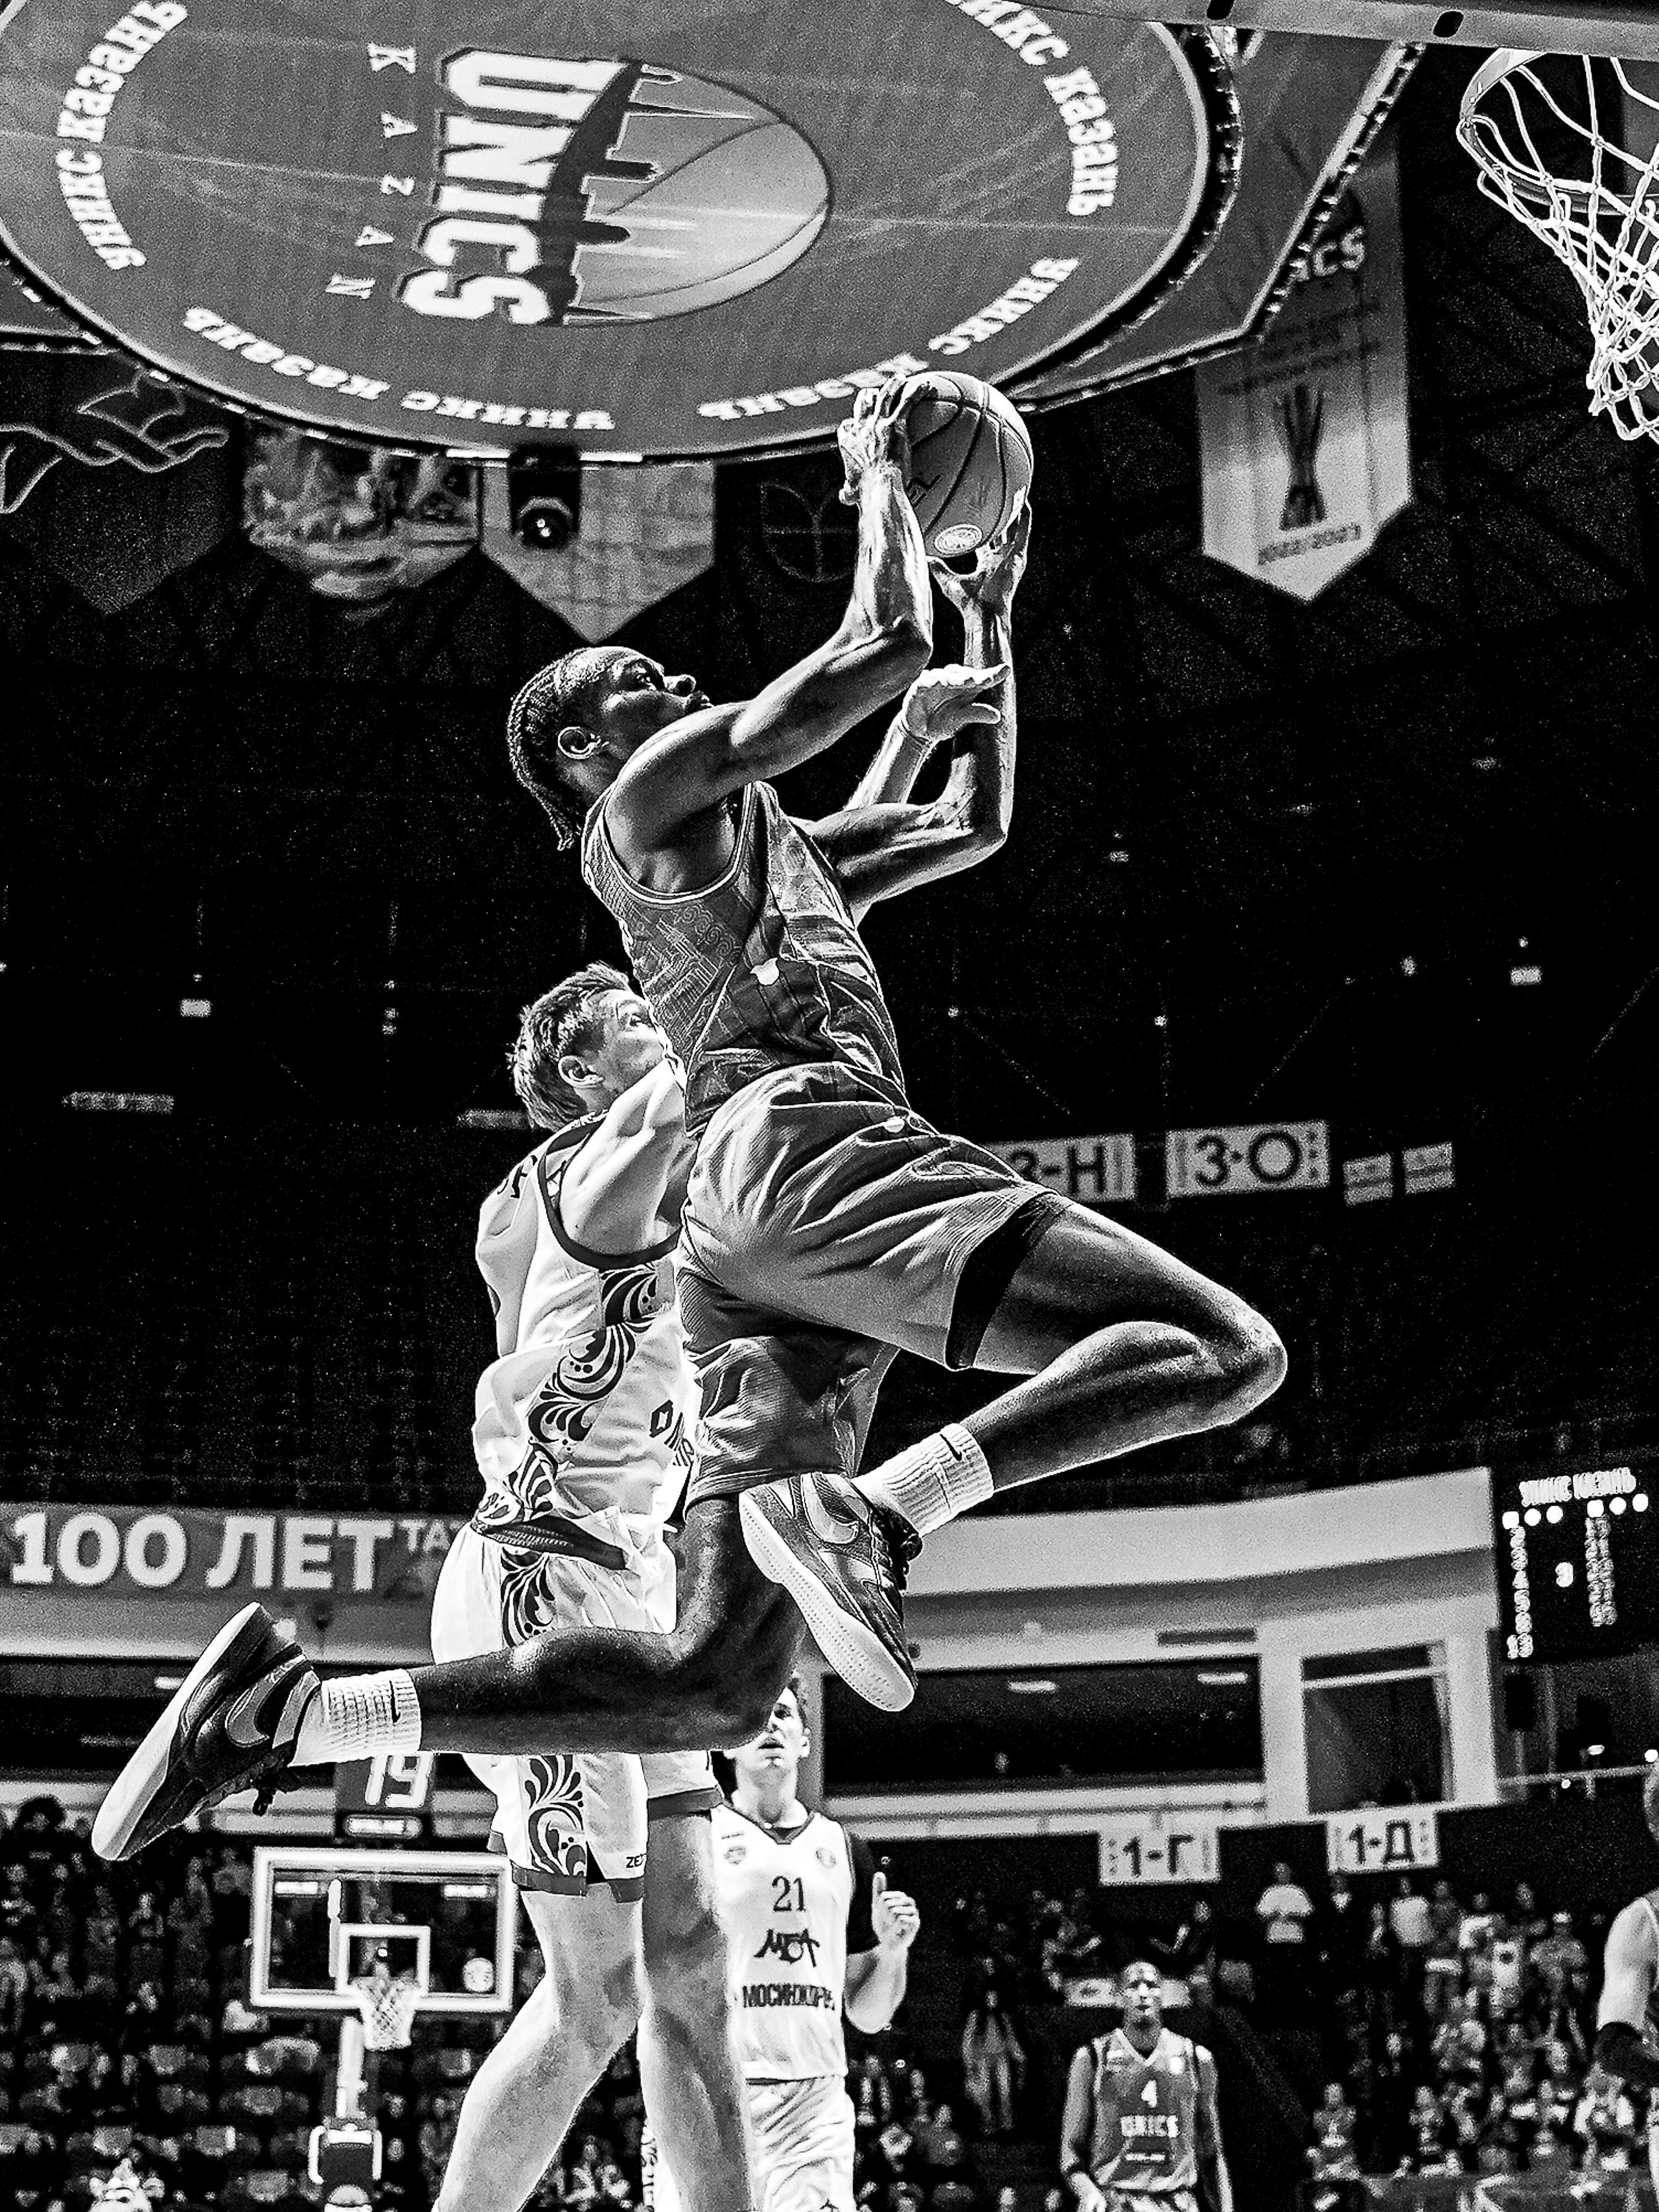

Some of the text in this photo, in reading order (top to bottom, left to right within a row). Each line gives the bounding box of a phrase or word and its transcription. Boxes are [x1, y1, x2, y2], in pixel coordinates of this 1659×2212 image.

[57, 1, 188, 143] Казань
[400, 50, 629, 324] UNICS
[1043, 66, 1119, 216] Казань
[12, 1513, 468, 1590] 100 ЛЕТ ТА
[772, 1875, 806, 1911] 21
[1141, 2079, 1157, 2108] 4
